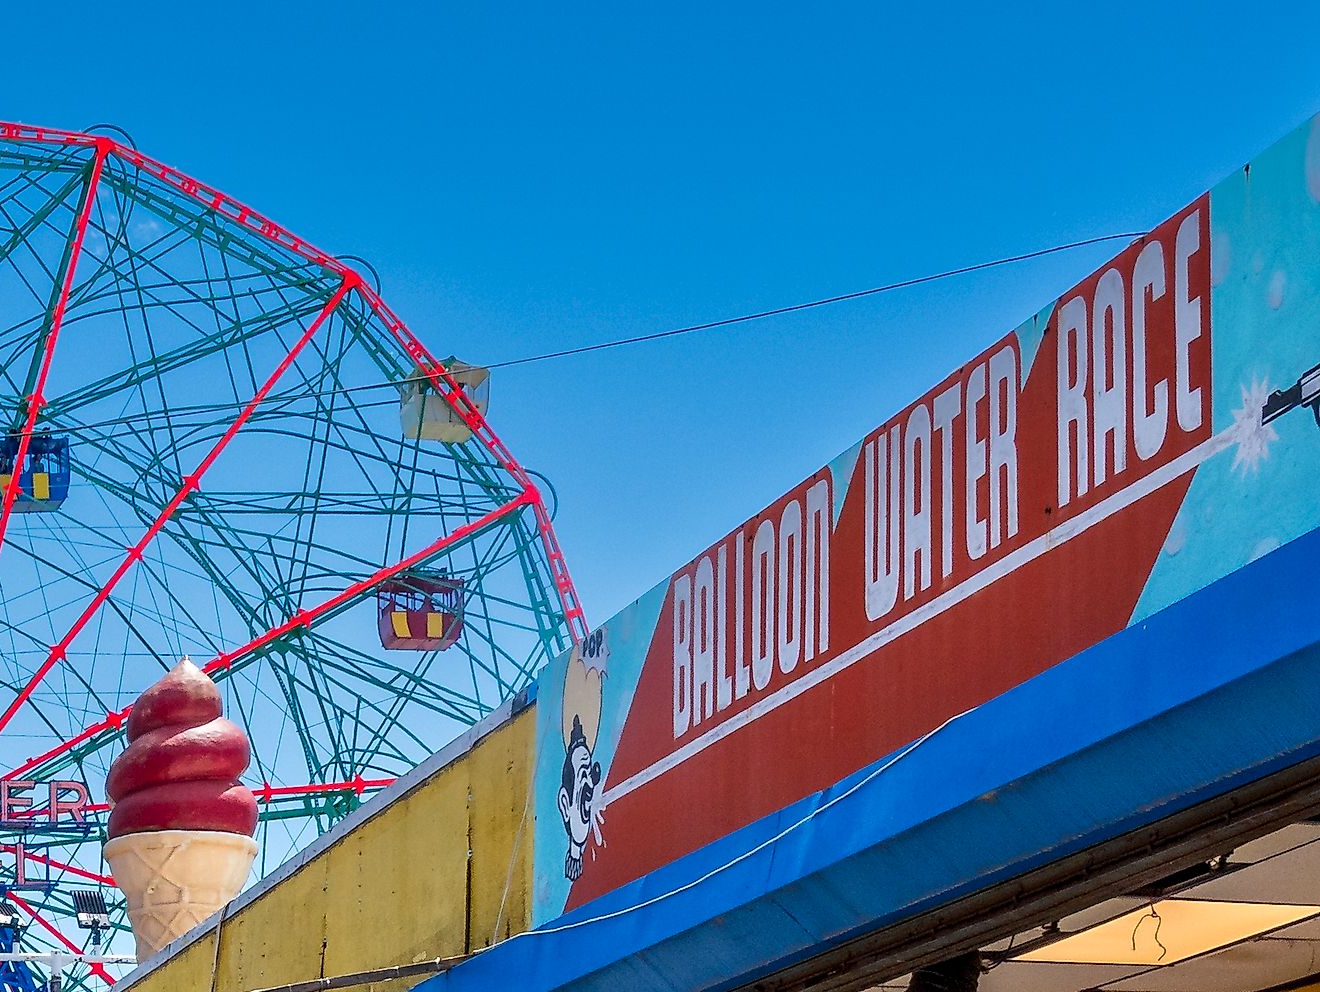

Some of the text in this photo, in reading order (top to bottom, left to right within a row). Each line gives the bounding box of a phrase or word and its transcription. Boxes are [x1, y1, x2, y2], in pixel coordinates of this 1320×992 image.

[672, 208, 1203, 741] BALLOON WATER RACE
